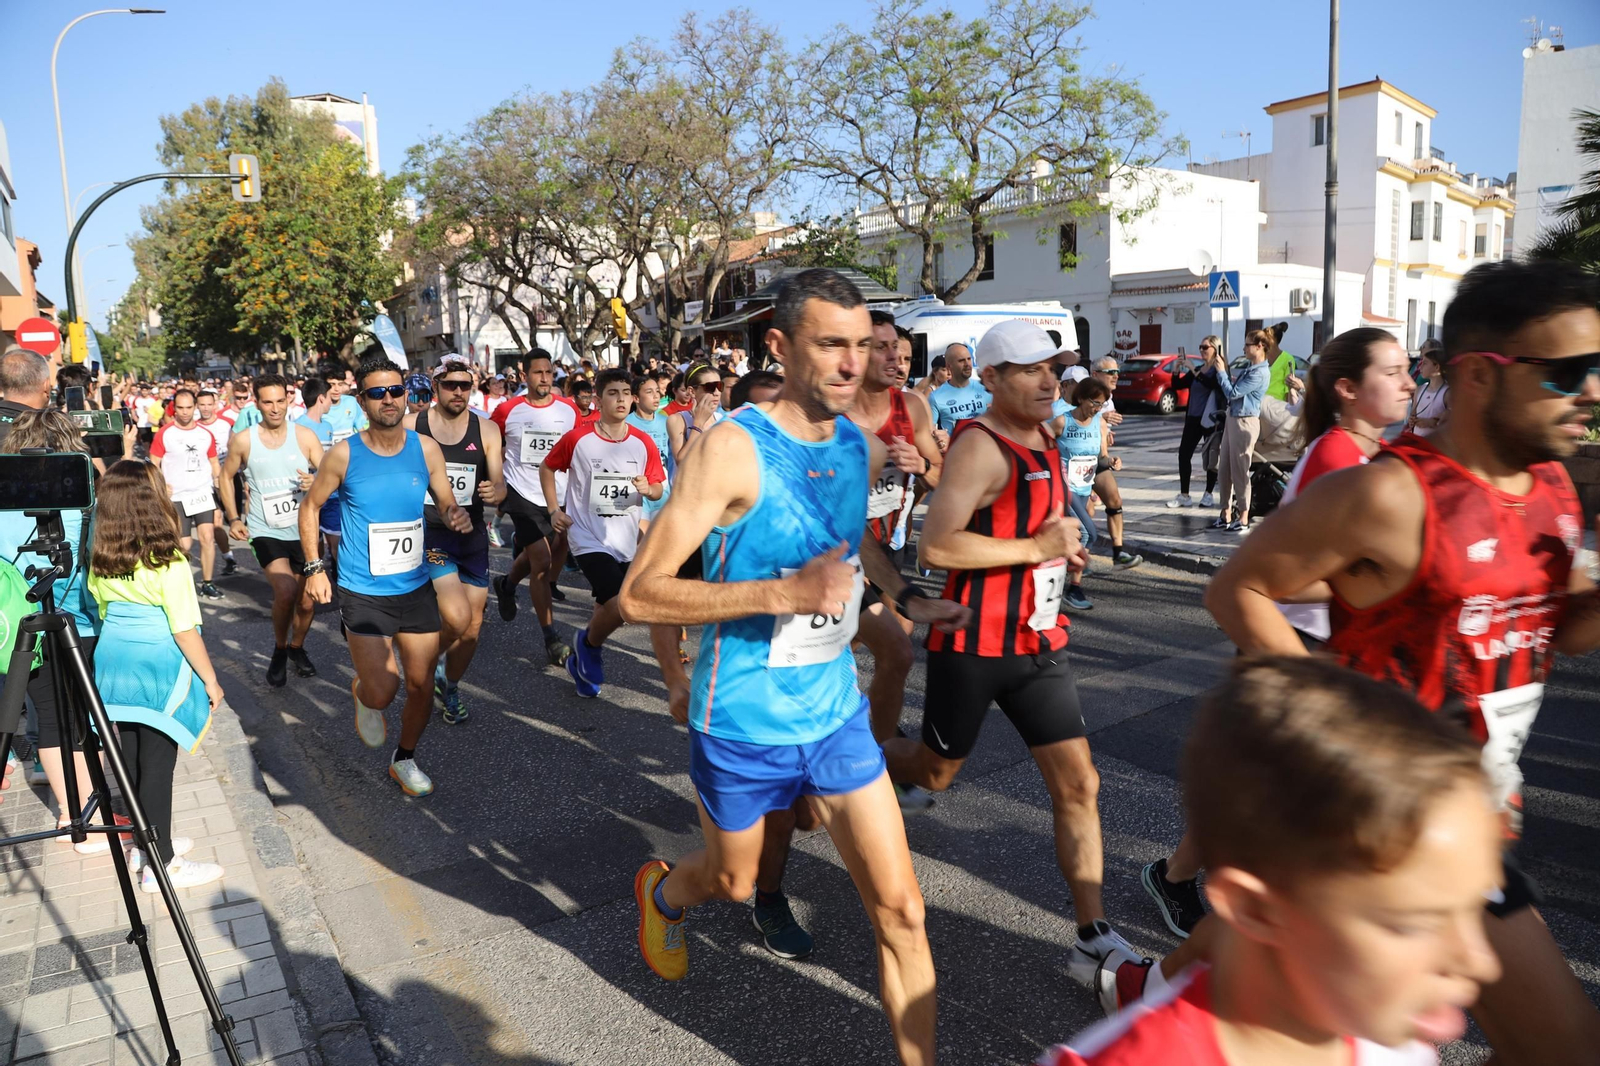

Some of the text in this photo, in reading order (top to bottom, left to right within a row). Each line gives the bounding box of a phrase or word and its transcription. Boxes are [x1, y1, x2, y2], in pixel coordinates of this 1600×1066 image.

[1013, 317, 1062, 326] BULANCIA
[1116, 329, 1132, 339] BAR
[949, 400, 983, 414] nerja
[1066, 430, 1092, 440] nerja
[529, 438, 554, 451] 435
[599, 484, 630, 499] 434
[869, 474, 895, 496] 06
[273, 498, 299, 516] 102
[388, 537, 413, 555] 70
